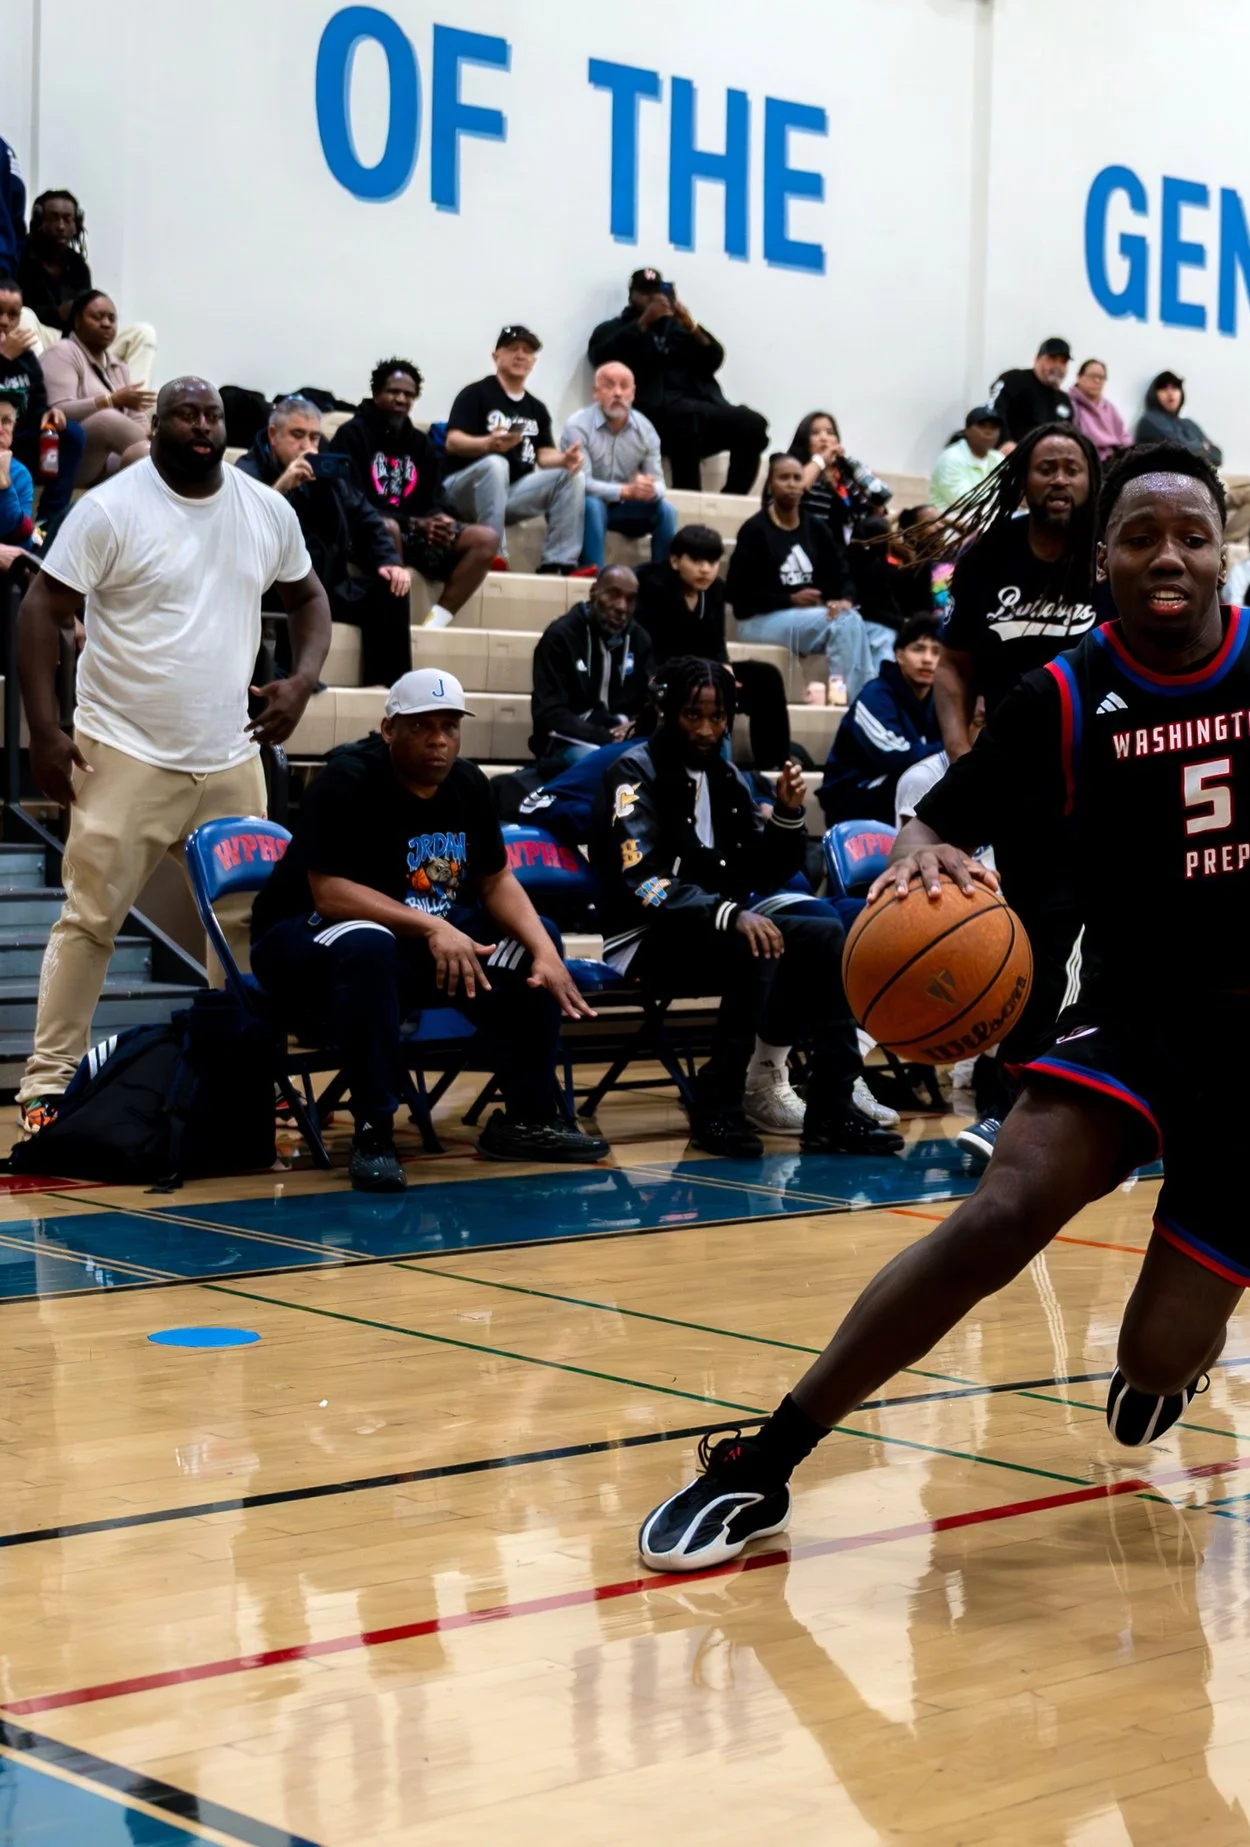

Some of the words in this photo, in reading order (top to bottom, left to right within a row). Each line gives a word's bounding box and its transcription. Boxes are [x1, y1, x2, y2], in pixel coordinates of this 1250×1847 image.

[316, 5, 512, 214] OF
[588, 57, 829, 276] THE
[432, 678, 445, 697] J
[1182, 755, 1233, 836] 5
[921, 975, 1027, 1061] Wilson
